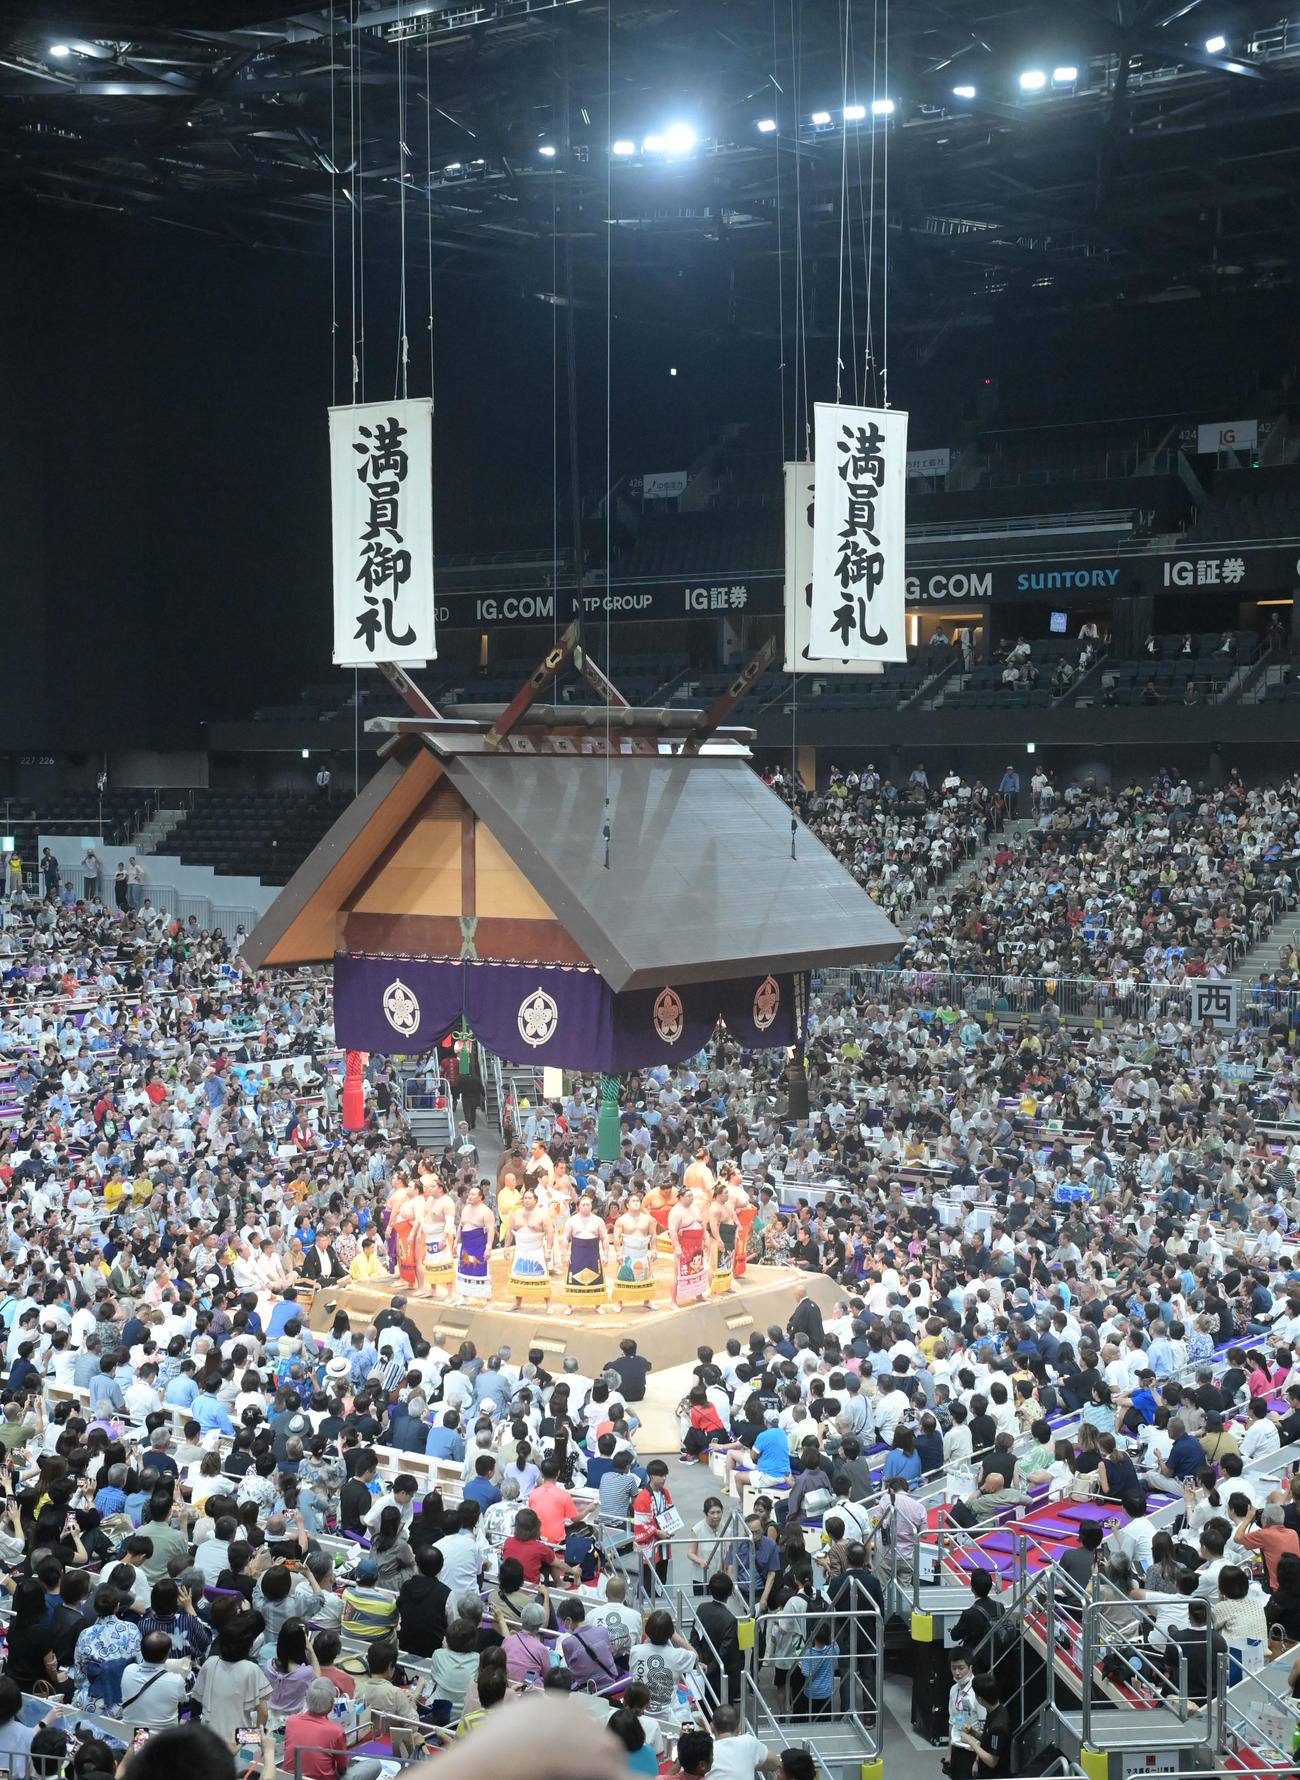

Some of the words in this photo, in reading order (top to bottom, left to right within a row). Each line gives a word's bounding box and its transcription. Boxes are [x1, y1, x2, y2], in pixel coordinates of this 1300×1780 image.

[1219, 429, 1236, 446] IG
[1259, 423, 1276, 433] 42
[352, 416, 417, 653] 満員御礼
[829, 421, 889, 647] 満員御礼
[1018, 569, 1120, 591] SUNTORY
[1163, 557, 1246, 587] IG証券
[685, 586, 748, 610] IG証券
[905, 572, 993, 601] G.COM
[476, 597, 554, 620] IG.COM
[603, 595, 653, 610] GROUP
[1196, 984, 1232, 1022] 西
